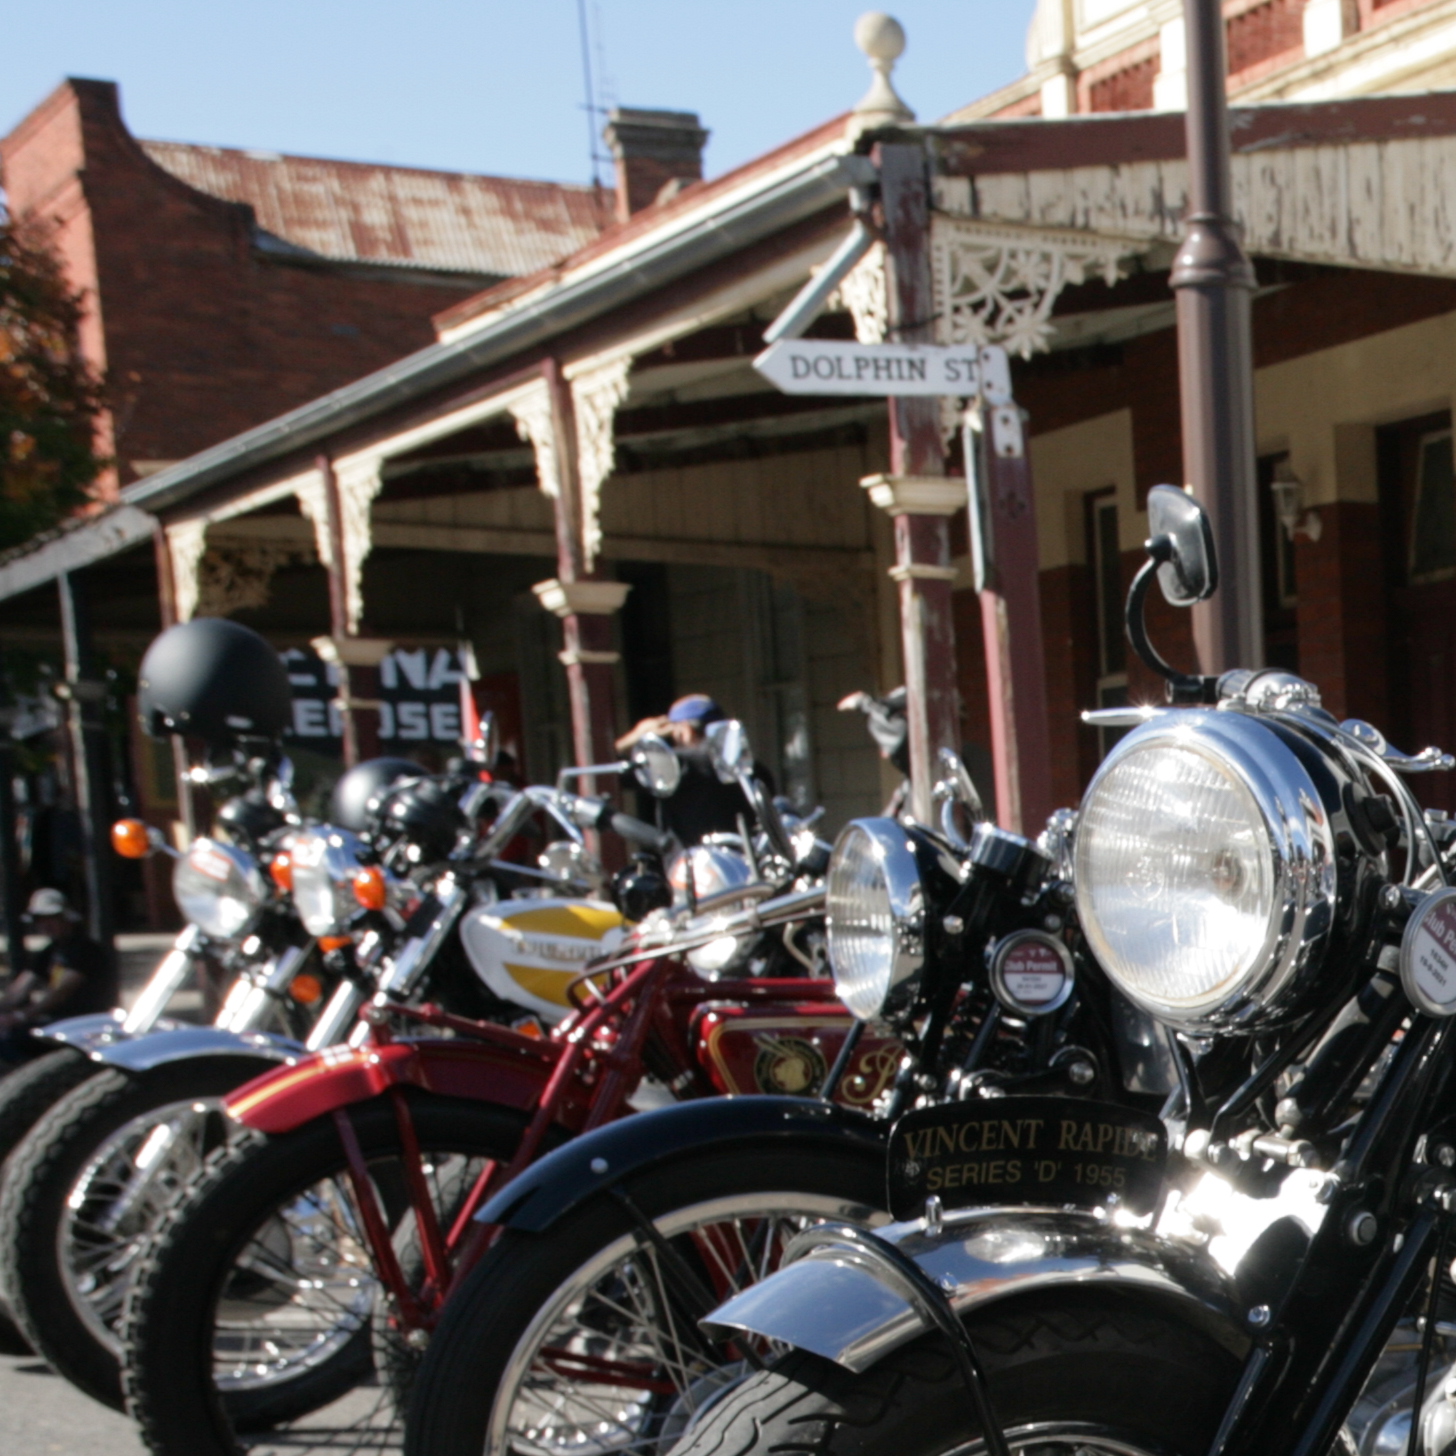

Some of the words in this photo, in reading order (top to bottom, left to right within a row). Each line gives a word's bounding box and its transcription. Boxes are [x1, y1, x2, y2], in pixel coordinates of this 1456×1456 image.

[791, 355, 926, 380] DOLPHIN
[944, 358, 979, 383] ST
[903, 1119, 1043, 1161] VINCENT
[1057, 1121, 1159, 1162] RAPIDE
[926, 1160, 1021, 1190] SERIES
[1074, 1162, 1126, 1188] 1955
